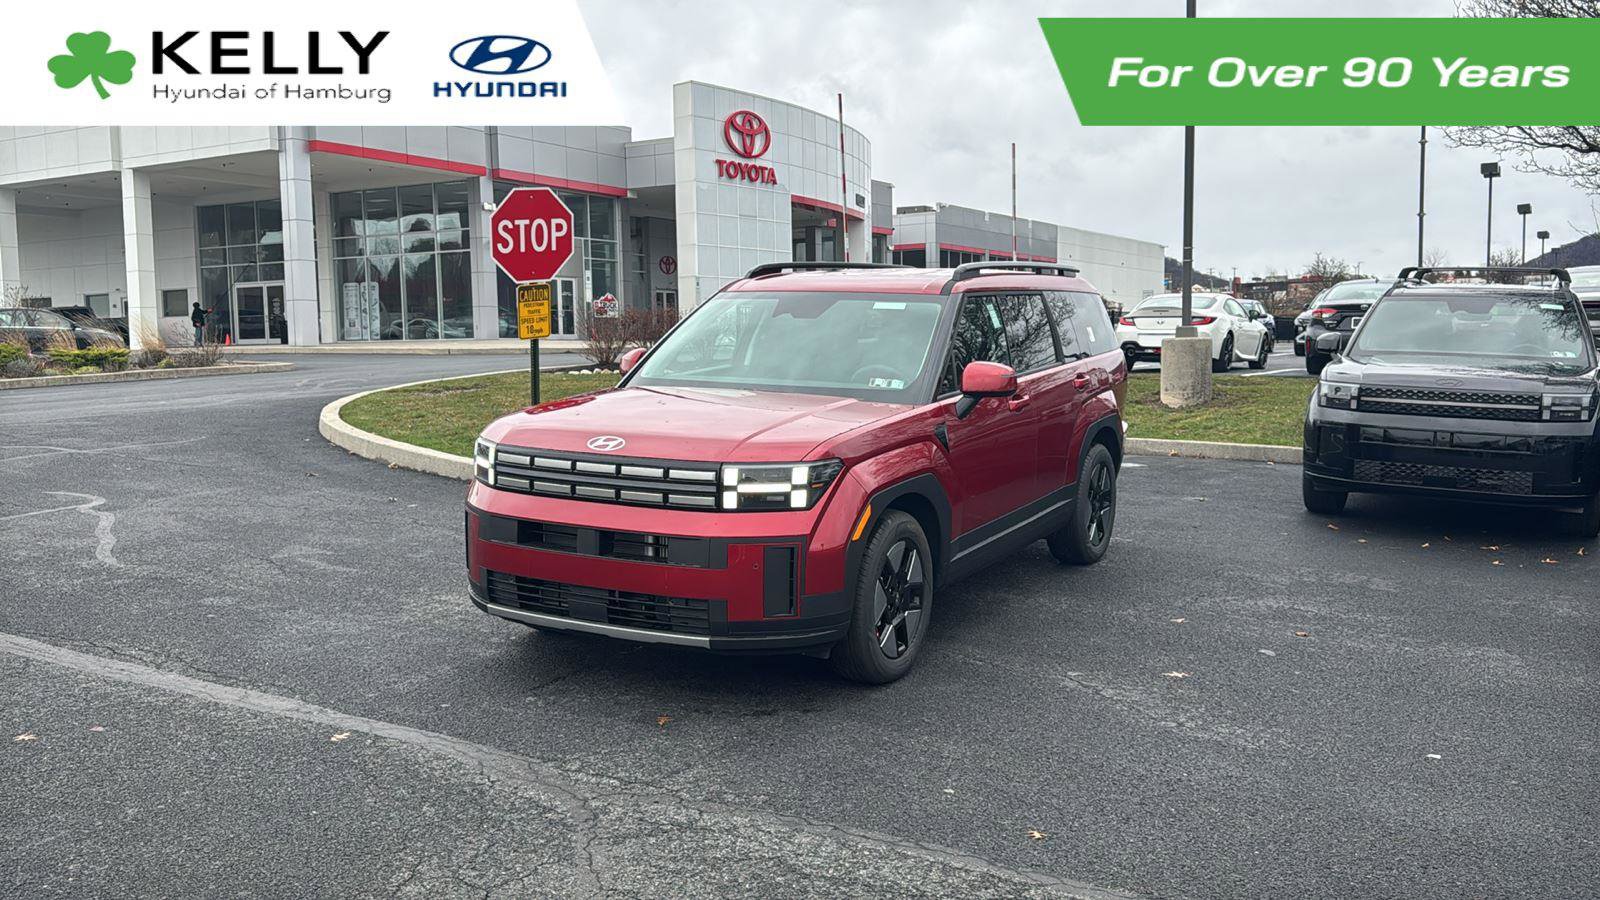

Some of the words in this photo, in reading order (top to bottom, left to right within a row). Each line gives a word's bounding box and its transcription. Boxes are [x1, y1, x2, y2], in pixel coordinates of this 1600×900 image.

[716, 159, 777, 185] TOYOTA
[497, 218, 568, 254] STOP
[520, 288, 549, 301] CAUTION
